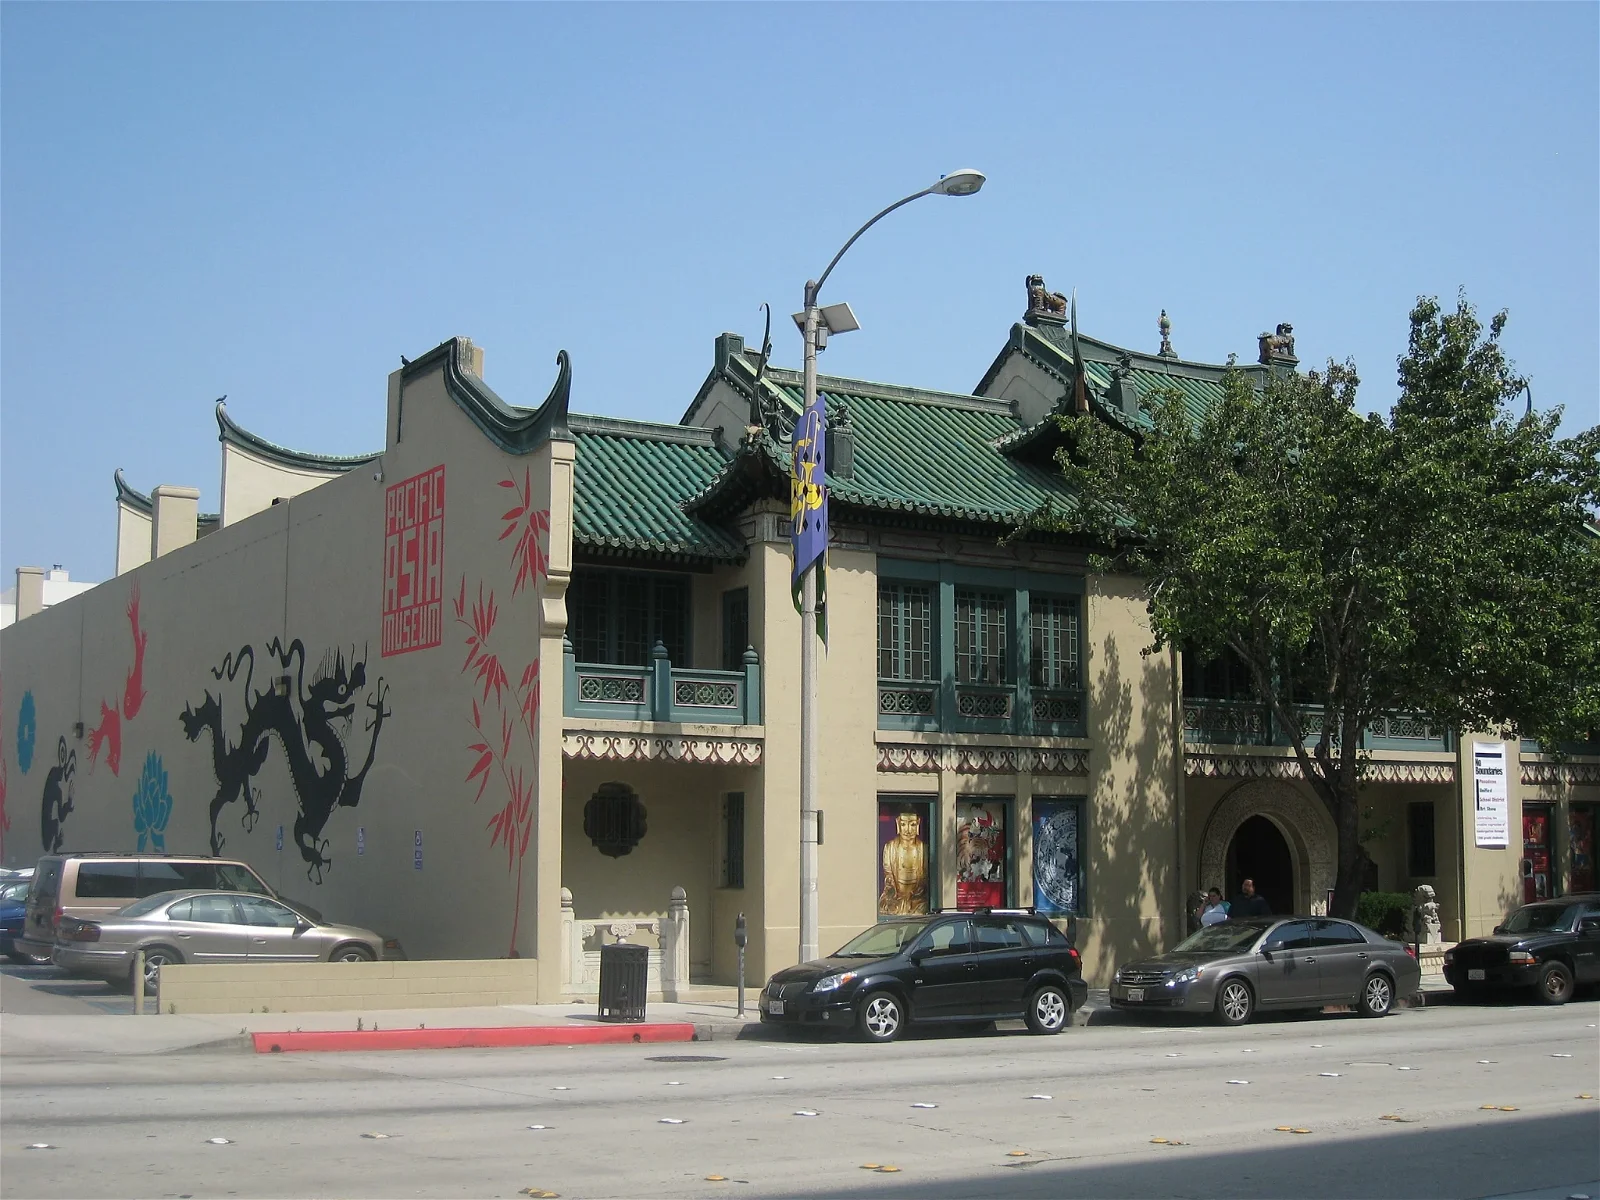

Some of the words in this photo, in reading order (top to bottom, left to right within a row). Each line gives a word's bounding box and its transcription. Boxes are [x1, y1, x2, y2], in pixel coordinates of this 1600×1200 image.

[387, 469, 443, 536] PACIFIC
[384, 518, 443, 613] ASIA
[382, 602, 441, 653] MUSEUM
[1475, 767, 1503, 775] Boundaries
